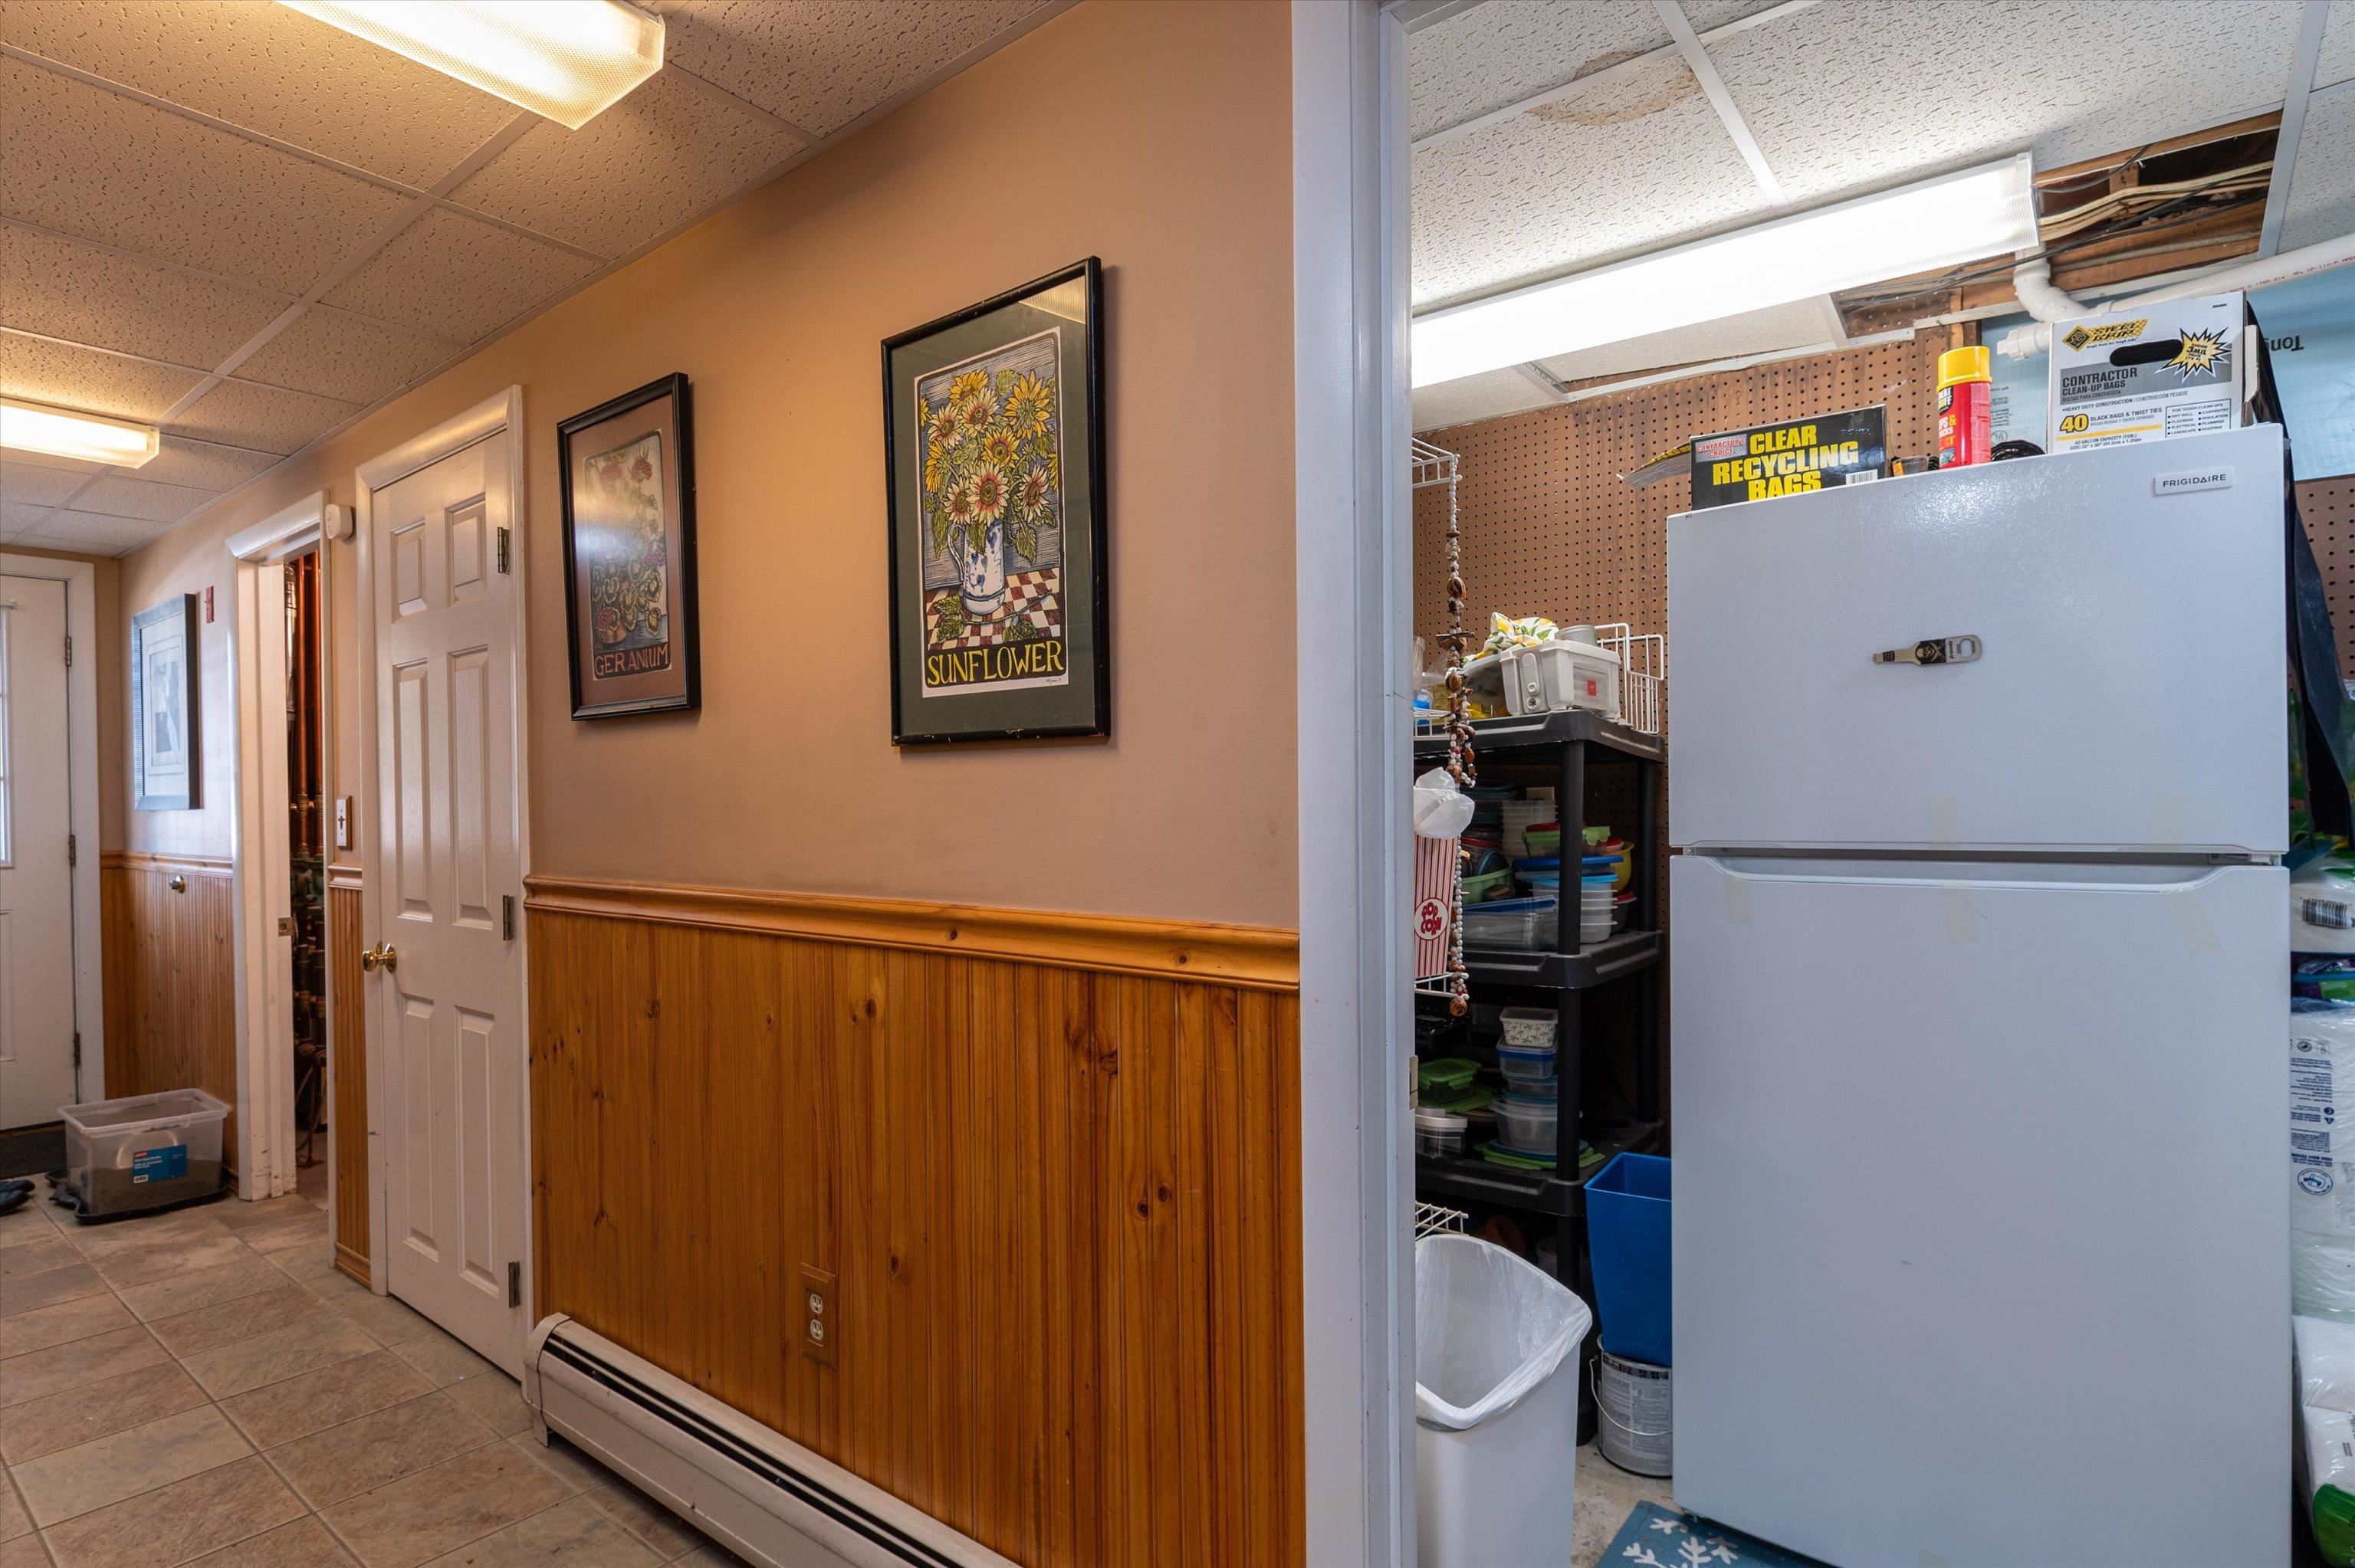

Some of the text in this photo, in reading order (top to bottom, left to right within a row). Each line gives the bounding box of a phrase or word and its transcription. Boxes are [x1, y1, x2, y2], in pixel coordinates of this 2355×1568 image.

[2062, 367, 2137, 388] CONTRACTOR
[2062, 379, 2126, 396] CLEAN-UP BAGS
[2092, 389, 2121, 399] CONTRATISTA
[2095, 399, 2133, 408] CONSTRUCTION
[1949, 414, 1956, 426] &
[2059, 413, 2089, 434] 40
[1696, 437, 1746, 453] CONTRACTOR'S
[1749, 425, 1817, 454] CLEAR
[1709, 448, 1734, 458] CHOICE
[1713, 441, 1859, 486] RECYCLING
[1748, 470, 1821, 503] BAGS
[2163, 474, 2226, 488] FRIGIDAIRE
[594, 644, 668, 676] GERANIUM
[927, 640, 1065, 686] SUNFLOWER
[1421, 901, 1439, 920] POP
[1421, 917, 1443, 936] CORN
